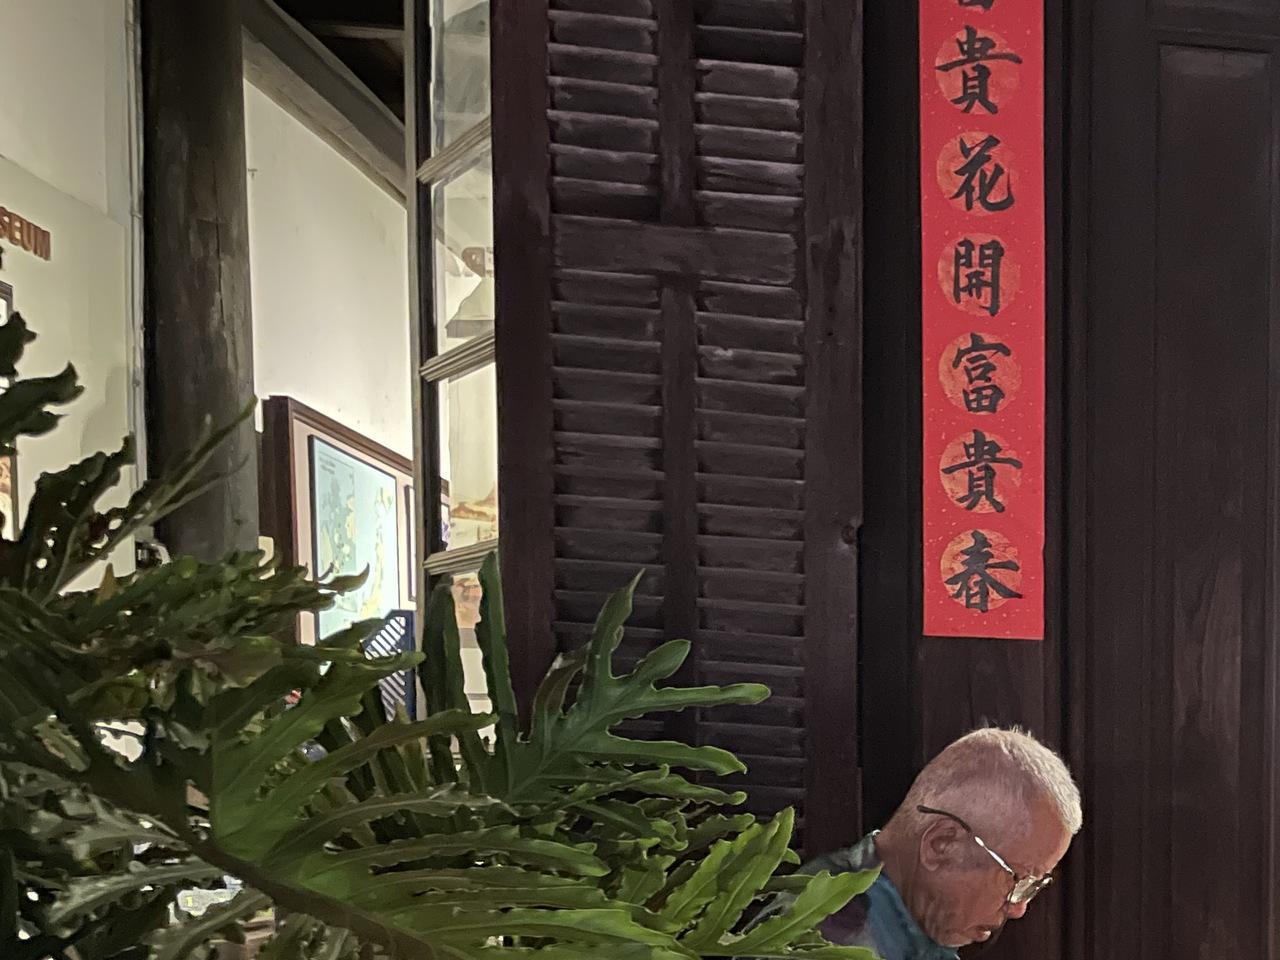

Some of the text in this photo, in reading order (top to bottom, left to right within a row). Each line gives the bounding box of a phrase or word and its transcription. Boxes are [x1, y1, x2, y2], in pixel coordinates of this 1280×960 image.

[935, 0, 1024, 613] 貴花開富貴春
